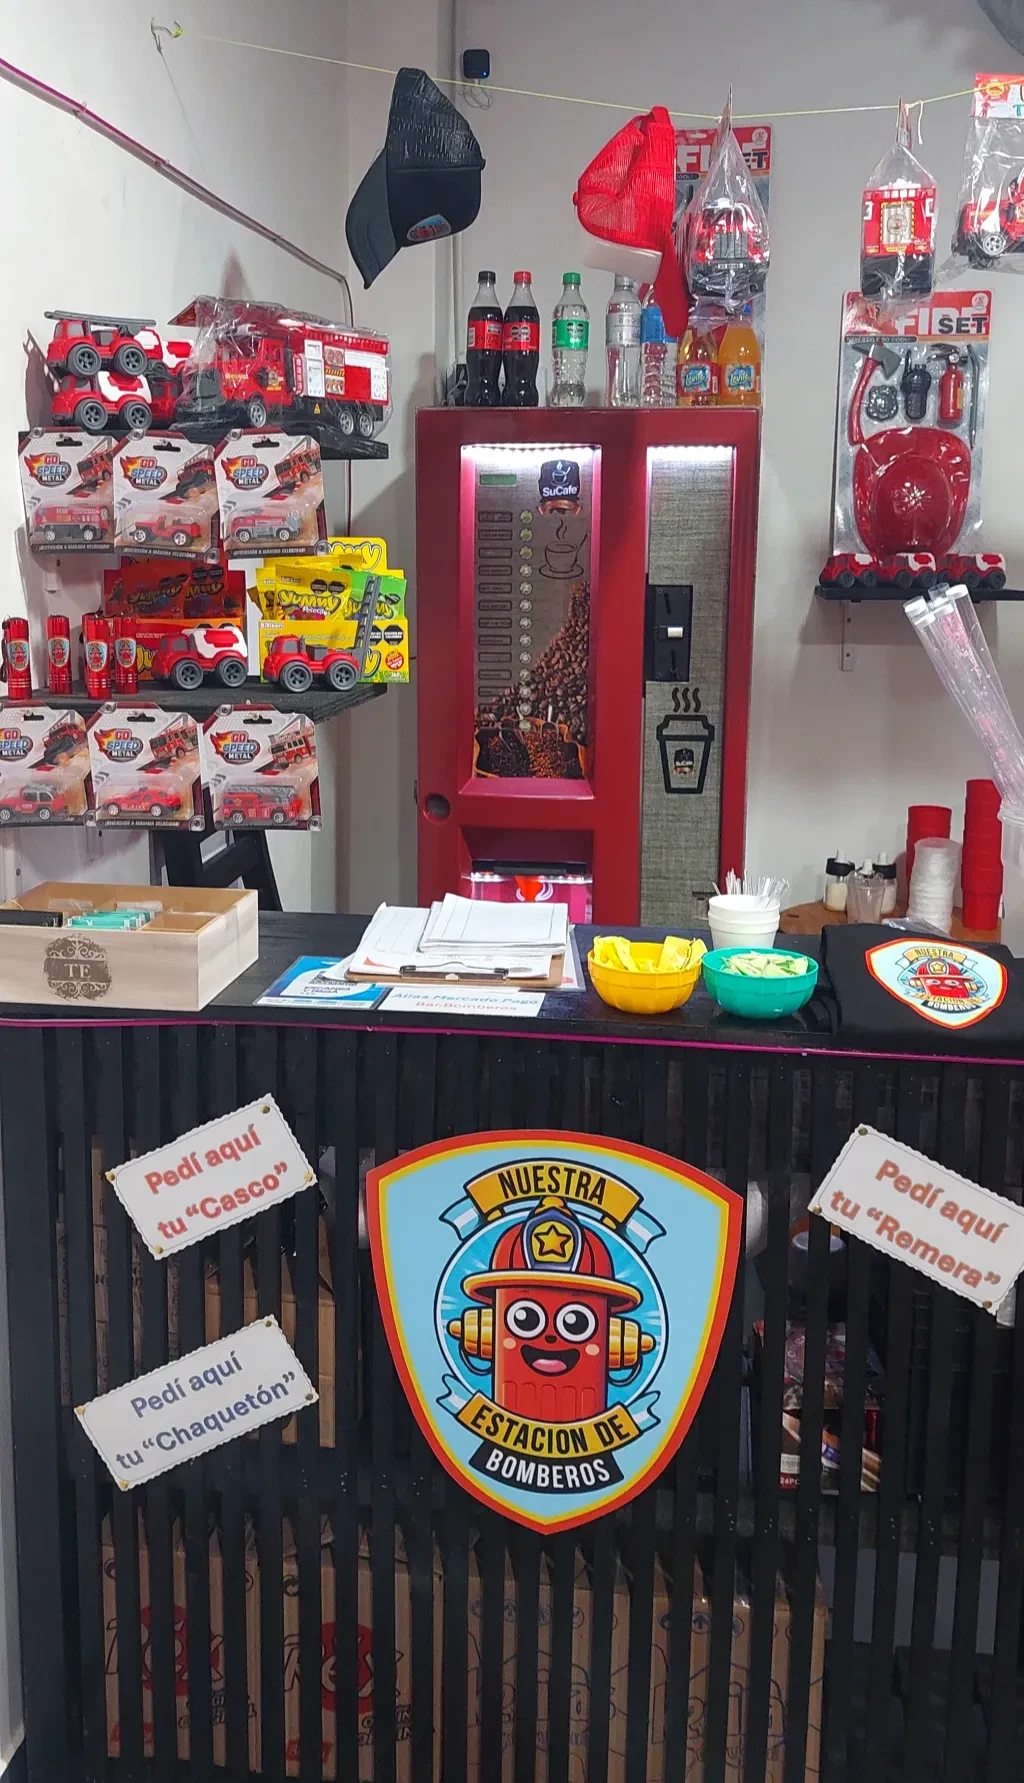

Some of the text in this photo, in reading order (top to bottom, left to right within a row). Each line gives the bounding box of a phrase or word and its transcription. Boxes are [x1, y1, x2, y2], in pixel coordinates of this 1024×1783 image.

[938, 317, 987, 334] SET
[45, 456, 58, 464] GO
[141, 459, 155, 468] GO
[242, 457, 256, 466] GO
[37, 466, 67, 474] SPEED
[131, 469, 163, 478] SPEED
[233, 467, 264, 477] SPEED
[238, 477, 261, 485] METAL
[543, 486, 578, 497] SuCafe
[5, 730, 18, 739] GO
[116, 731, 129, 740] GO
[232, 733, 246, 742] GO
[107, 740, 138, 750] SPEED
[223, 743, 256, 752] SPEED
[914, 948, 954, 959] NUESTRA
[64, 963, 91, 979] TE
[433, 994, 498, 1004] Mercado
[502, 997, 539, 1006] Pago
[144, 1123, 262, 1195] Pedí aquí
[497, 1165, 608, 1206] NUESTRA
[830, 1190, 861, 1221] tu
[875, 1159, 1010, 1244] Pedí aquí
[157, 1216, 188, 1240] tu
[129, 1350, 243, 1419] Pedí aquí
[470, 1404, 631, 1454] ESTACION DE
[115, 1449, 144, 1470] tu
[485, 1448, 611, 1489] BOMBEROS
